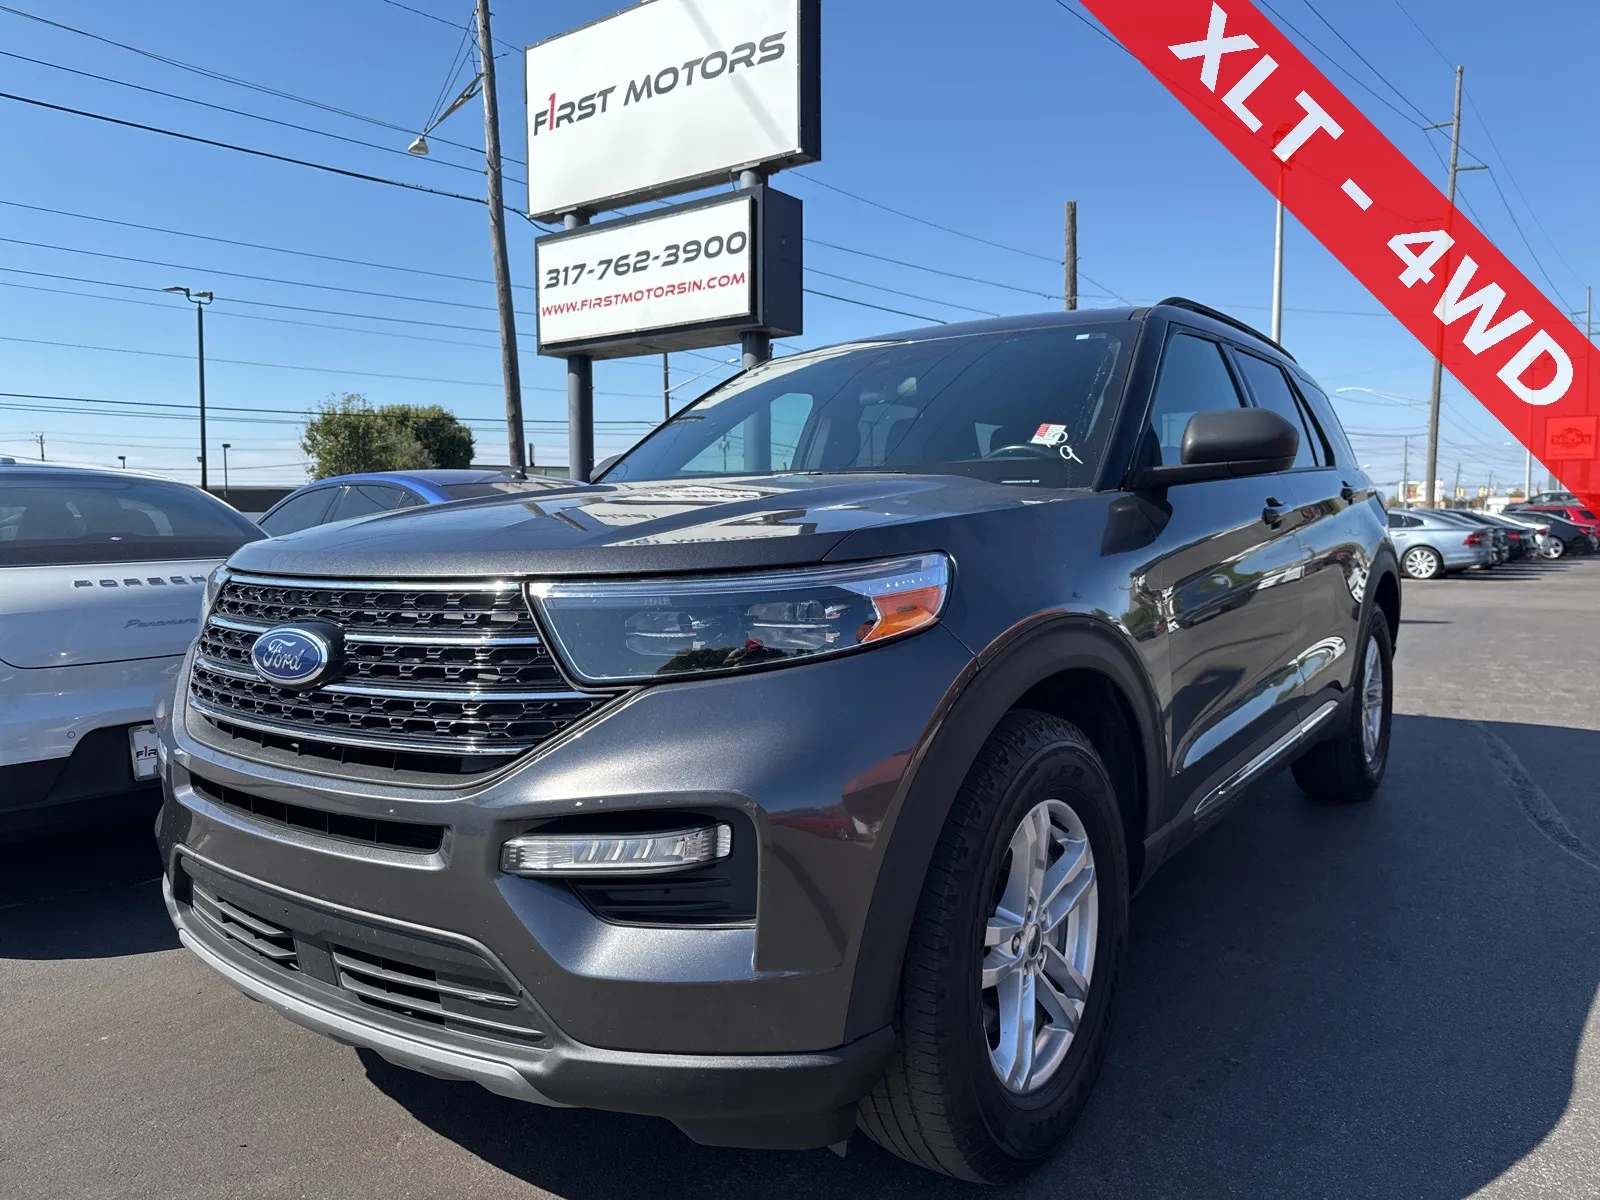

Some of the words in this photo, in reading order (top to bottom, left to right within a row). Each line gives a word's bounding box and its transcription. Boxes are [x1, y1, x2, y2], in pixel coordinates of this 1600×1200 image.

[623, 31, 787, 107] MOTORS
[544, 231, 747, 289] 317-762-3900
[541, 272, 745, 317] WWW.FIRSTMOTORSIN.COM
[72, 575, 207, 588] PORSCH
[263, 638, 305, 671] Ford
